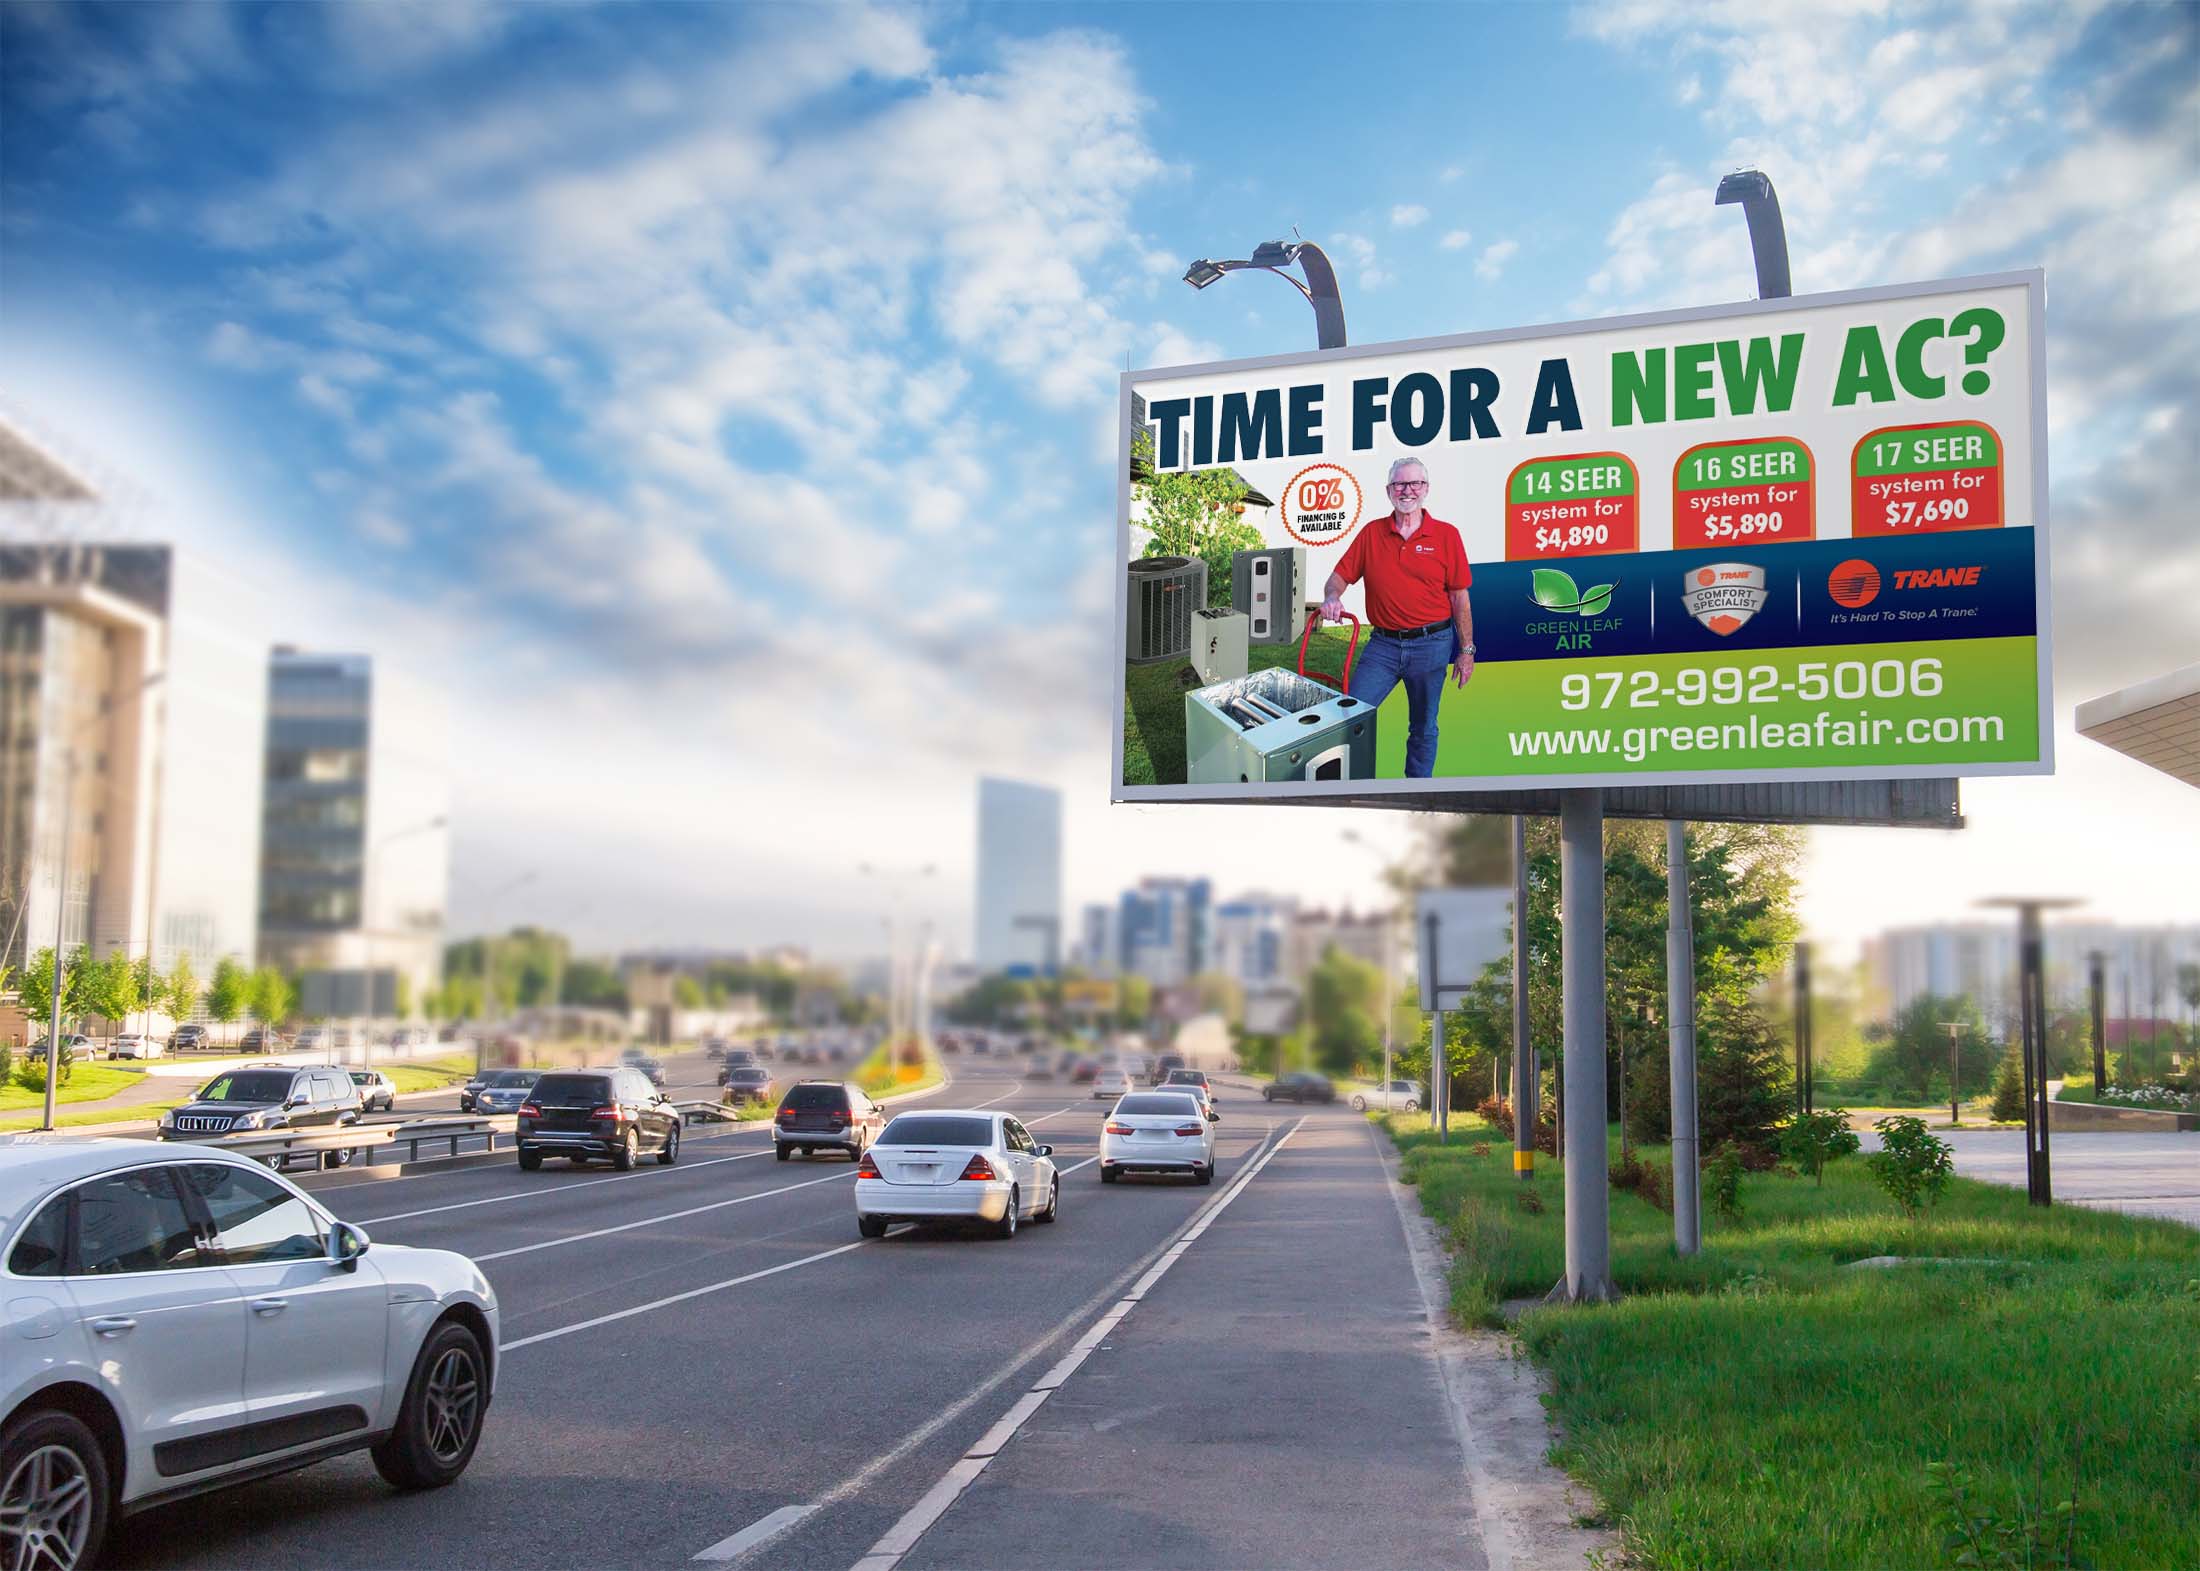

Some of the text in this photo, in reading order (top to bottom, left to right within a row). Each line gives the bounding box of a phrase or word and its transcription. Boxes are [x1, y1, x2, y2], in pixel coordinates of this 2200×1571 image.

[1149, 307, 2006, 469] TIME FOR A NEW AC?
[1872, 435, 1983, 467] 17 SEER
[1693, 451, 1796, 482] 16 SEER
[1299, 478, 1345, 511] 0%
[1524, 466, 1622, 496] 14 SEER
[1869, 471, 1985, 499] system for
[1521, 499, 1623, 526] system for
[1690, 485, 1798, 513] system for
[1885, 498, 1969, 527] $7,690
[1297, 511, 1346, 523] FINANCING IS
[1300, 521, 1342, 533] AVAILABLE
[1704, 511, 1783, 540] $5,890
[1535, 524, 1609, 552] $4,890
[1893, 566, 1982, 590] TRANE
[1693, 598, 1758, 611] SPECIALIST
[1696, 588, 1754, 601] COMFORT
[1525, 618, 1623, 635] GREEN LEAF
[1830, 613, 1847, 623] It's
[1850, 611, 1879, 623] Hard
[1882, 610, 1896, 621] To
[1899, 608, 1926, 621] Stop
[1928, 608, 1938, 618] A
[1555, 633, 1592, 651] AIR
[1560, 657, 1943, 711] 972-992-5006
[1508, 711, 2005, 762] www.greenleafair.com
